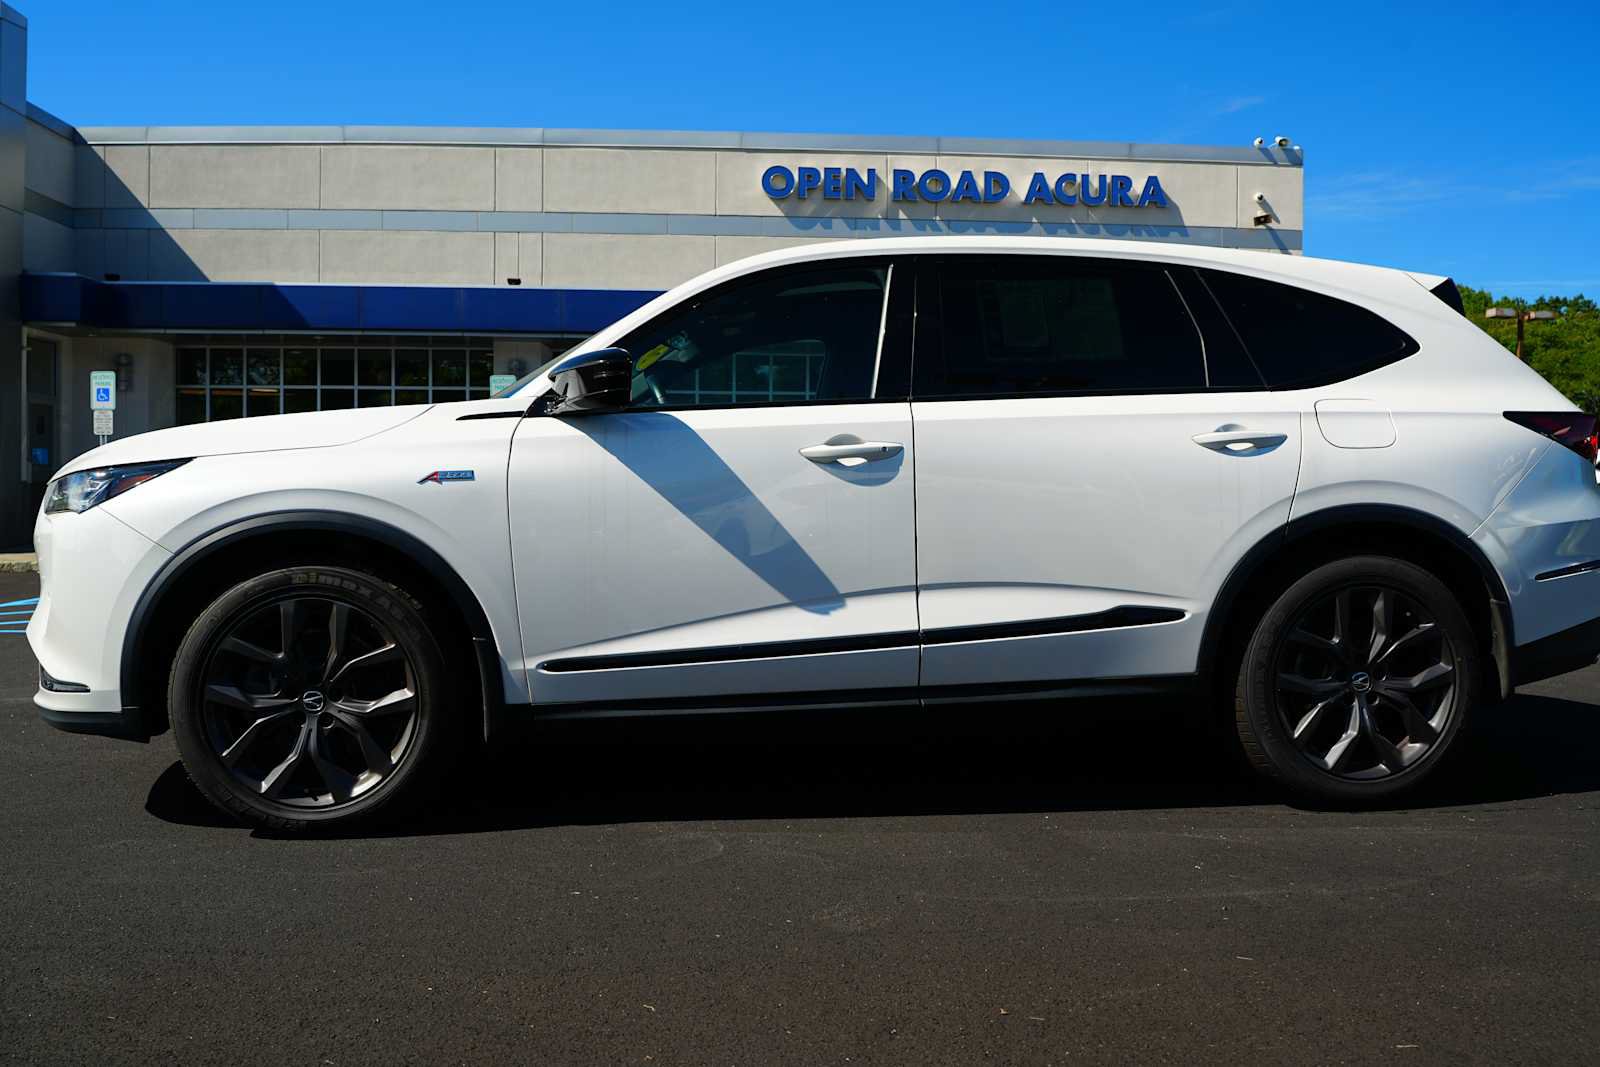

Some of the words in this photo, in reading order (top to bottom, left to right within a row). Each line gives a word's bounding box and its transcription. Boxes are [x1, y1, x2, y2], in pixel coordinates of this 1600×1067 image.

[761, 165, 878, 203] OPEN
[892, 168, 1011, 205] ROAD
[1024, 172, 1170, 209] ACURA
